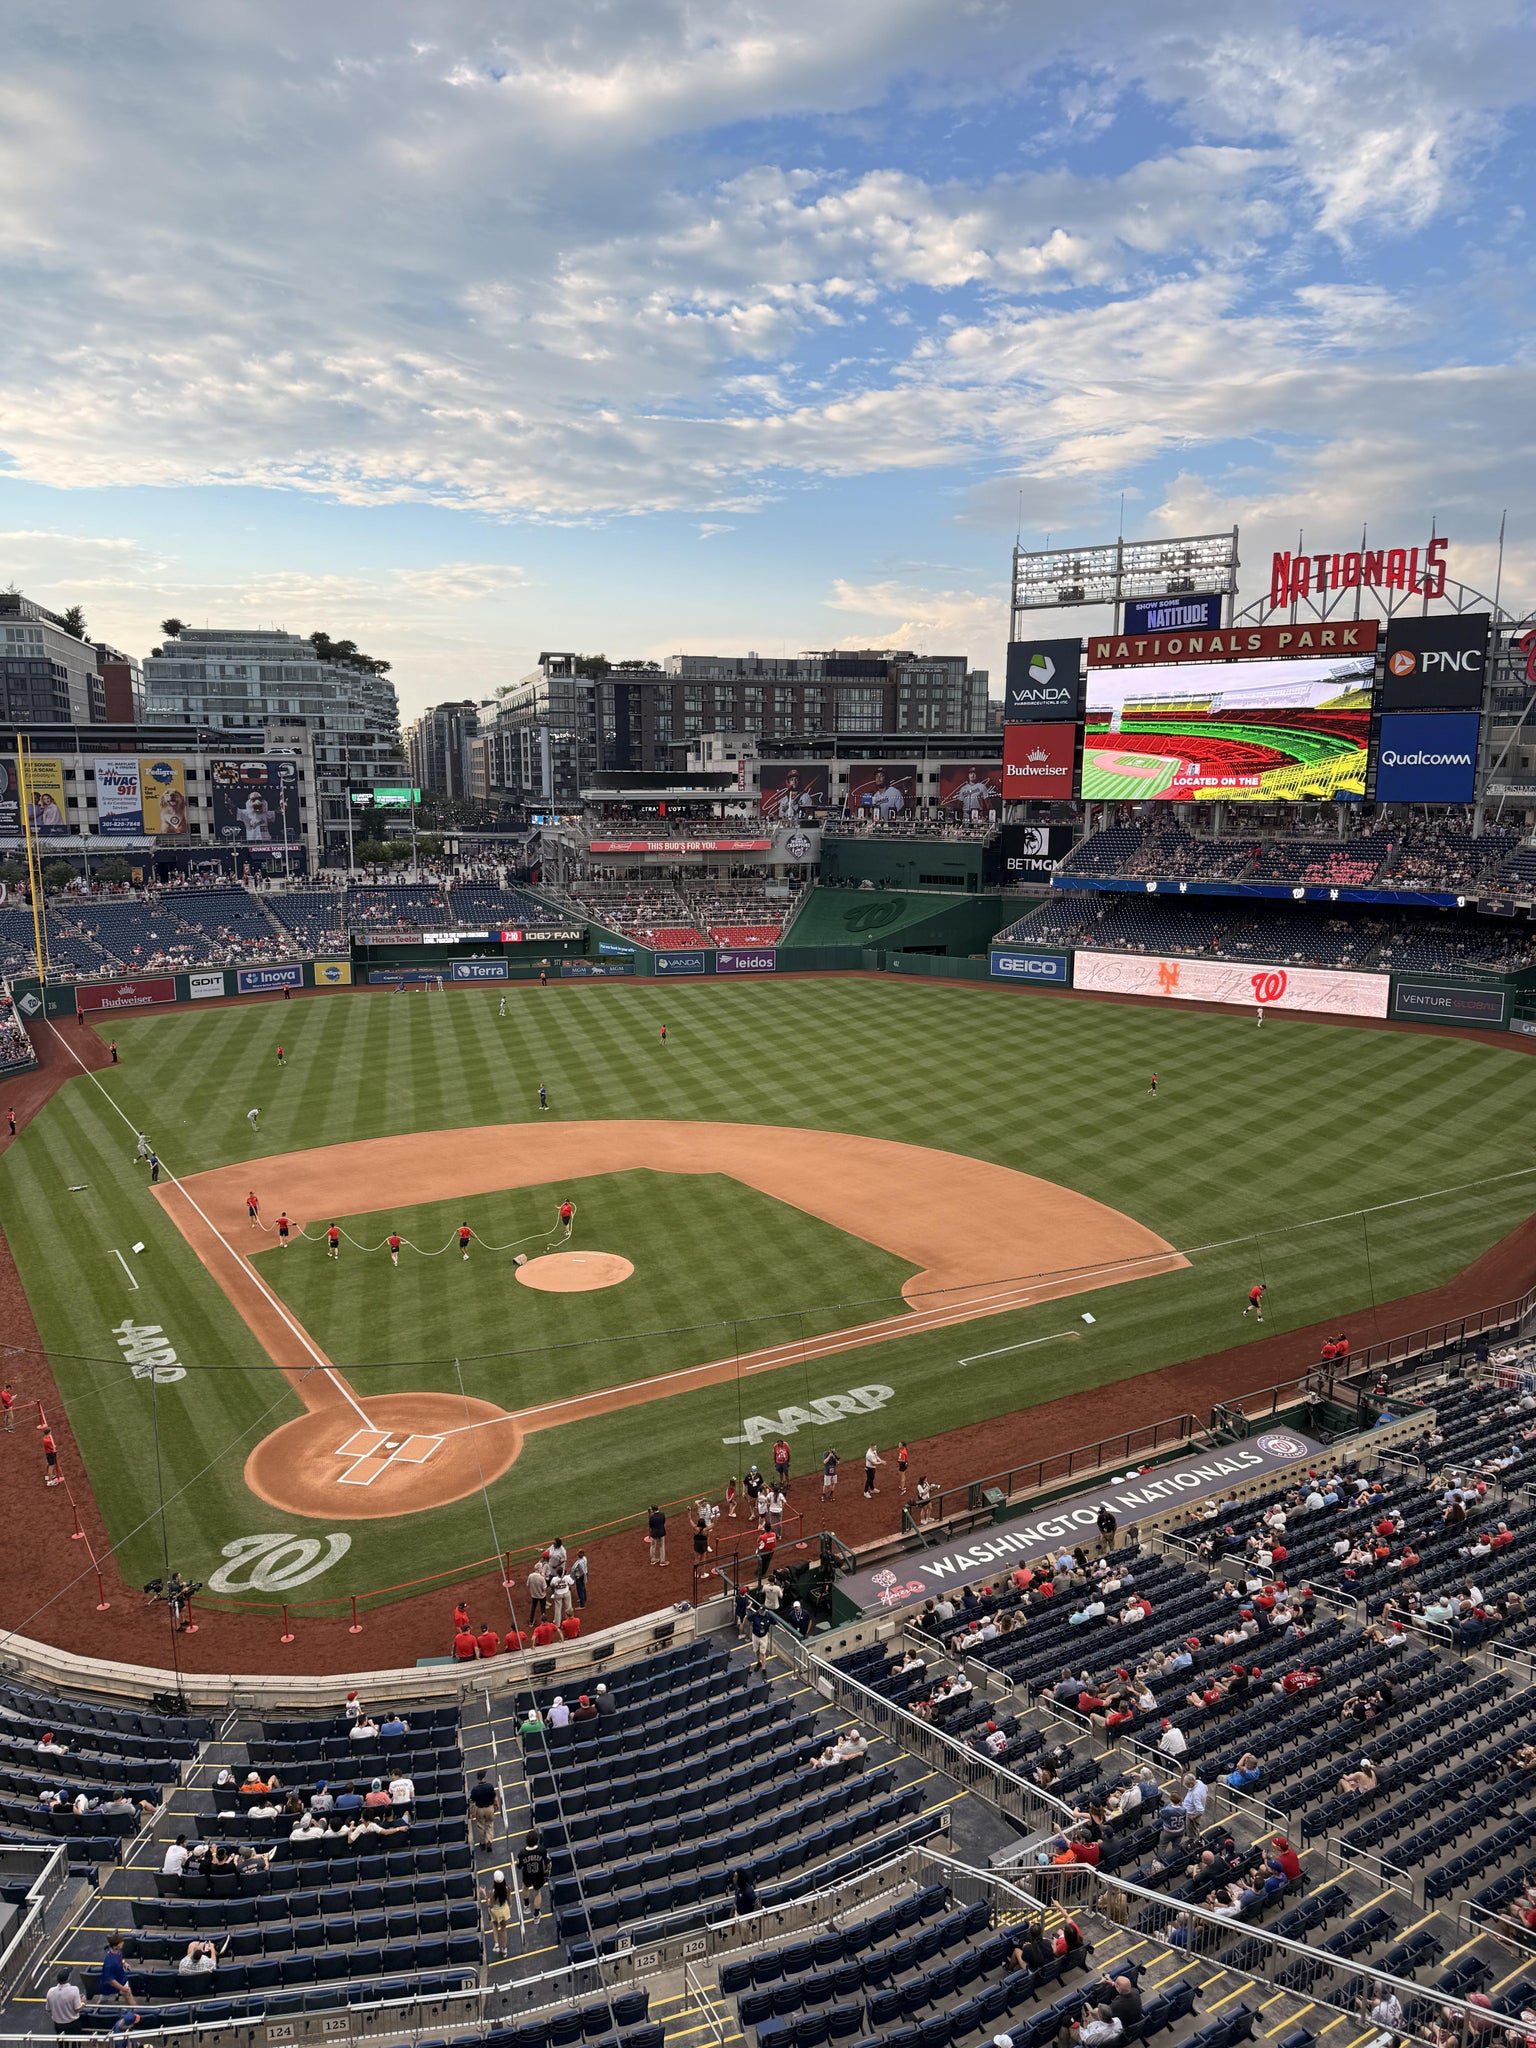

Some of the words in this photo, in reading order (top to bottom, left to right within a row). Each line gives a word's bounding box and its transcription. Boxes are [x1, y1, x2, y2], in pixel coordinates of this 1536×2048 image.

[1270, 538, 1448, 609] NATIONALS
[1135, 602, 1158, 611] SHOW
[1159, 599, 1180, 608] SOME
[1147, 603, 1208, 629] NATITUDE
[1097, 634, 1261, 659] NATIONALS
[1278, 628, 1360, 649] PARK
[1421, 649, 1482, 673] PNC
[1012, 688, 1071, 701] VANDA
[1382, 750, 1471, 767] Qualcomm
[145, 768, 178, 777] Pedigree
[1006, 764, 1068, 776] Budweiser
[103, 776, 138, 786] HVAC
[1173, 778, 1218, 786] LOCATED
[1221, 777, 1241, 786] ON
[1244, 777, 1259, 786] THE
[117, 785, 137, 795] 911
[647, 842, 664, 850] THIS
[664, 842, 686, 850] BUD'S
[687, 841, 701, 850] FOR
[701, 841, 717, 850] YOU.
[372, 936, 395, 944] Harris
[395, 935, 420, 943] Teeter
[505, 932, 518, 941] 7:10
[554, 931, 580, 939] FAN
[735, 956, 773, 969] leidos
[999, 958, 1057, 975] GEICO
[261, 970, 296, 983] Inova
[471, 966, 504, 976] Terra
[191, 976, 223, 987] GDIT
[101, 995, 153, 1008] Budweiser
[1403, 994, 1452, 1008] VENTURE
[1453, 998, 1497, 1011] GLOBAL
[111, 1319, 187, 1384] AARP
[721, 1384, 895, 1446] AARP
[919, 1500, 1123, 1579] WASHINGTON
[1115, 1451, 1264, 1509] NATIONALS
[207, 1532, 352, 1594] W
[621, 1939, 629, 1949] E
[637, 1954, 656, 1968] 125
[685, 1940, 704, 1954] 126
[464, 1980, 473, 1990] D
[268, 2026, 292, 2038] 124
[325, 2019, 347, 2031] 125
